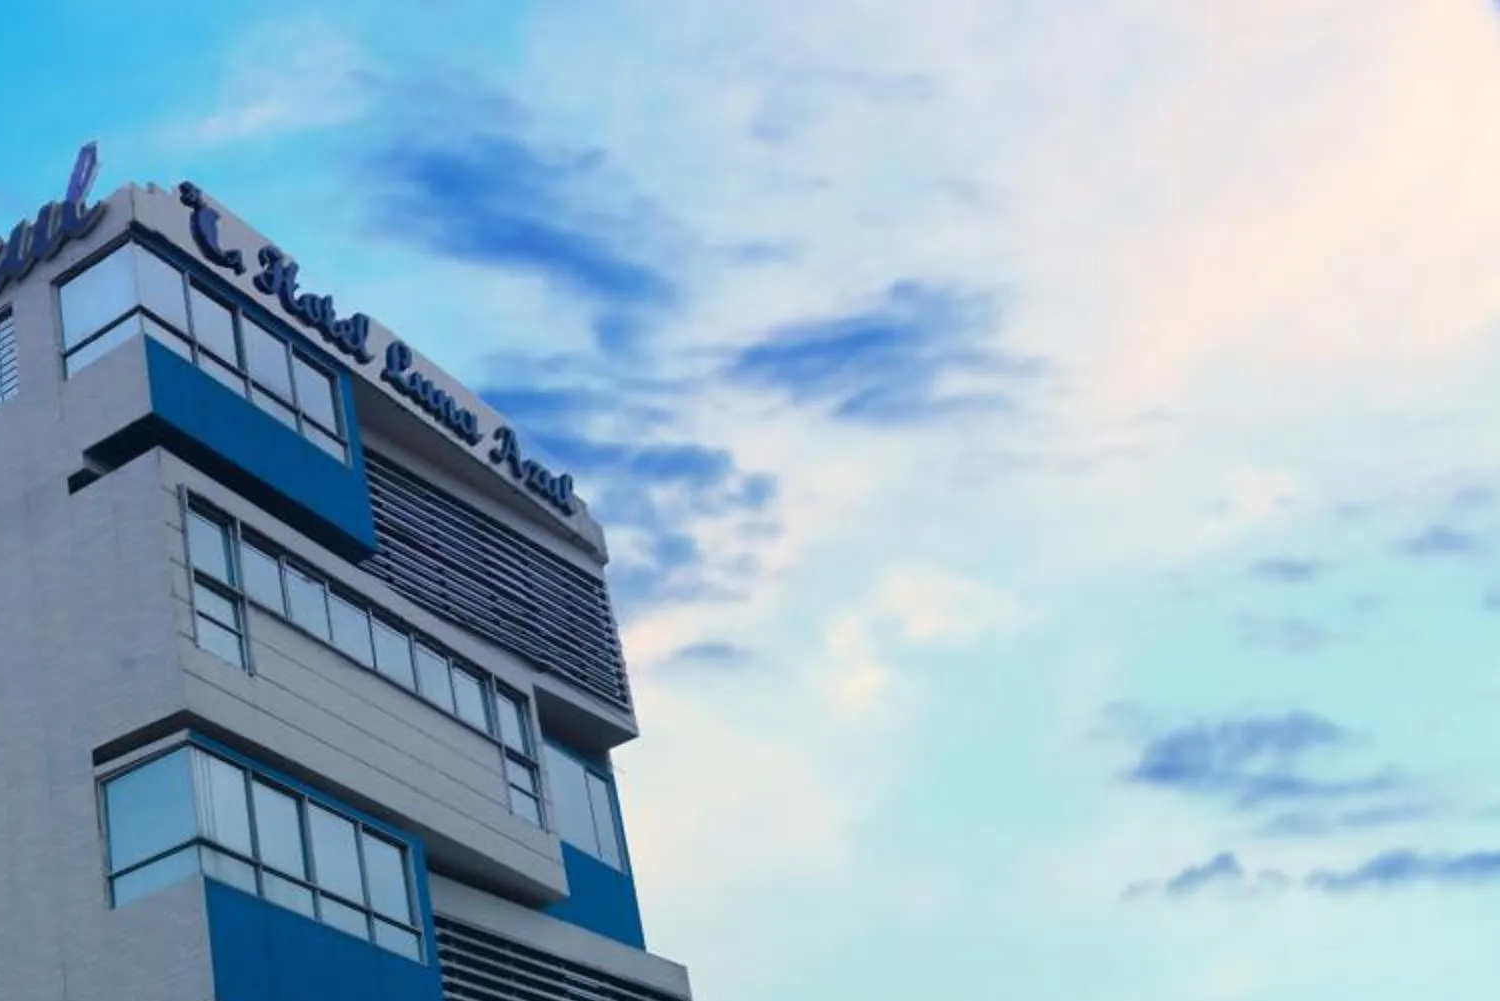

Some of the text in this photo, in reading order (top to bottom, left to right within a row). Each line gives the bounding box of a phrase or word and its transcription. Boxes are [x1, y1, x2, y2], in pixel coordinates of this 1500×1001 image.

[253, 245, 580, 518] Hotel Luna Azul
